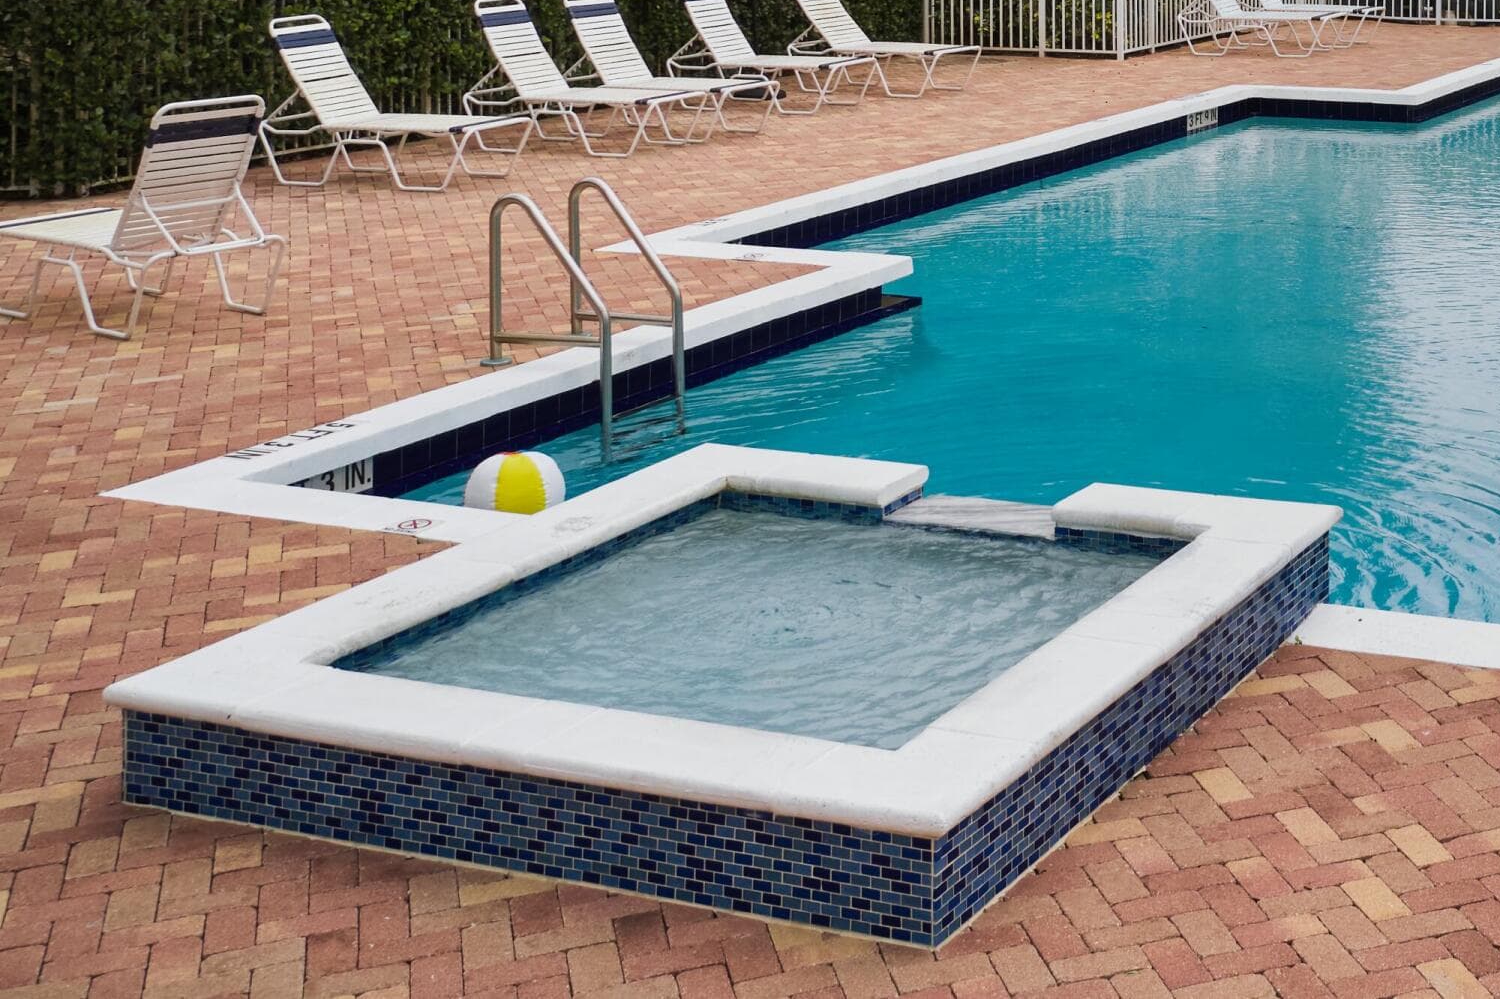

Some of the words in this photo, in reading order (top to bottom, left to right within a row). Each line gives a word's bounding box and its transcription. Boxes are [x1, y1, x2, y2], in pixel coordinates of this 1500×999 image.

[1189, 114, 1194, 127] 3
[290, 429, 334, 440] FT
[224, 449, 272, 460] IN
[320, 470, 335, 491] 3
[344, 458, 371, 490] IN.
